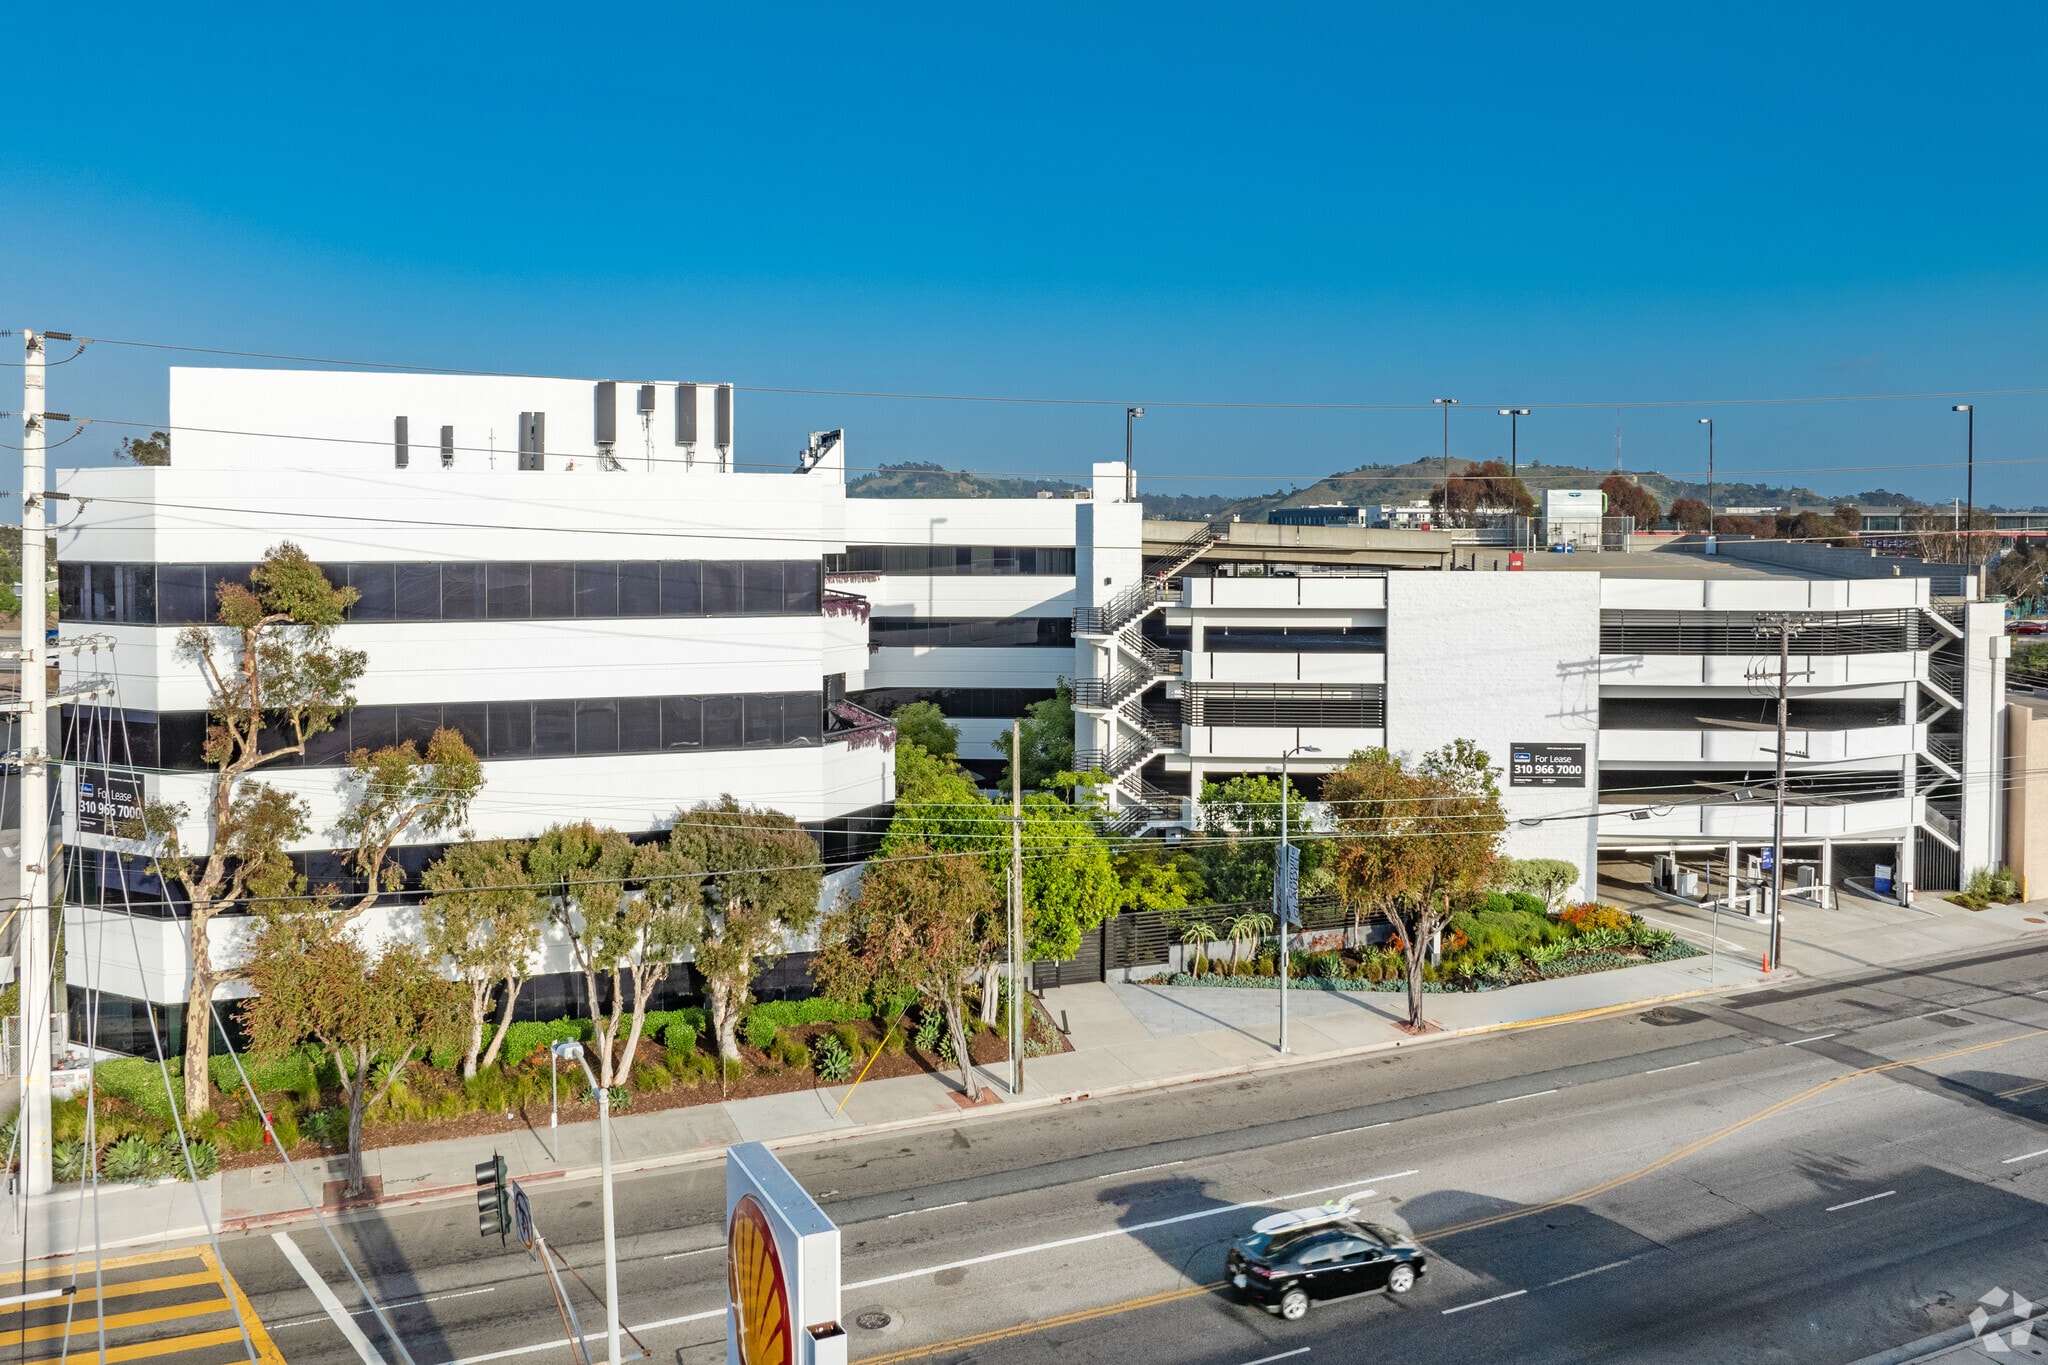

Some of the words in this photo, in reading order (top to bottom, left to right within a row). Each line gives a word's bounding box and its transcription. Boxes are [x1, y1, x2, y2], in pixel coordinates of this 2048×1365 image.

[1535, 755, 1548, 763] For
[1550, 755, 1572, 763] Lease
[1514, 764, 1533, 774] 310
[1535, 764, 1554, 774] 966
[1556, 764, 1582, 774] 7000
[97, 787, 110, 800] Fo
[111, 789, 132, 802] Lease
[80, 800, 96, 814] 310
[98, 802, 116, 817] 966
[117, 804, 141, 820] 7000
